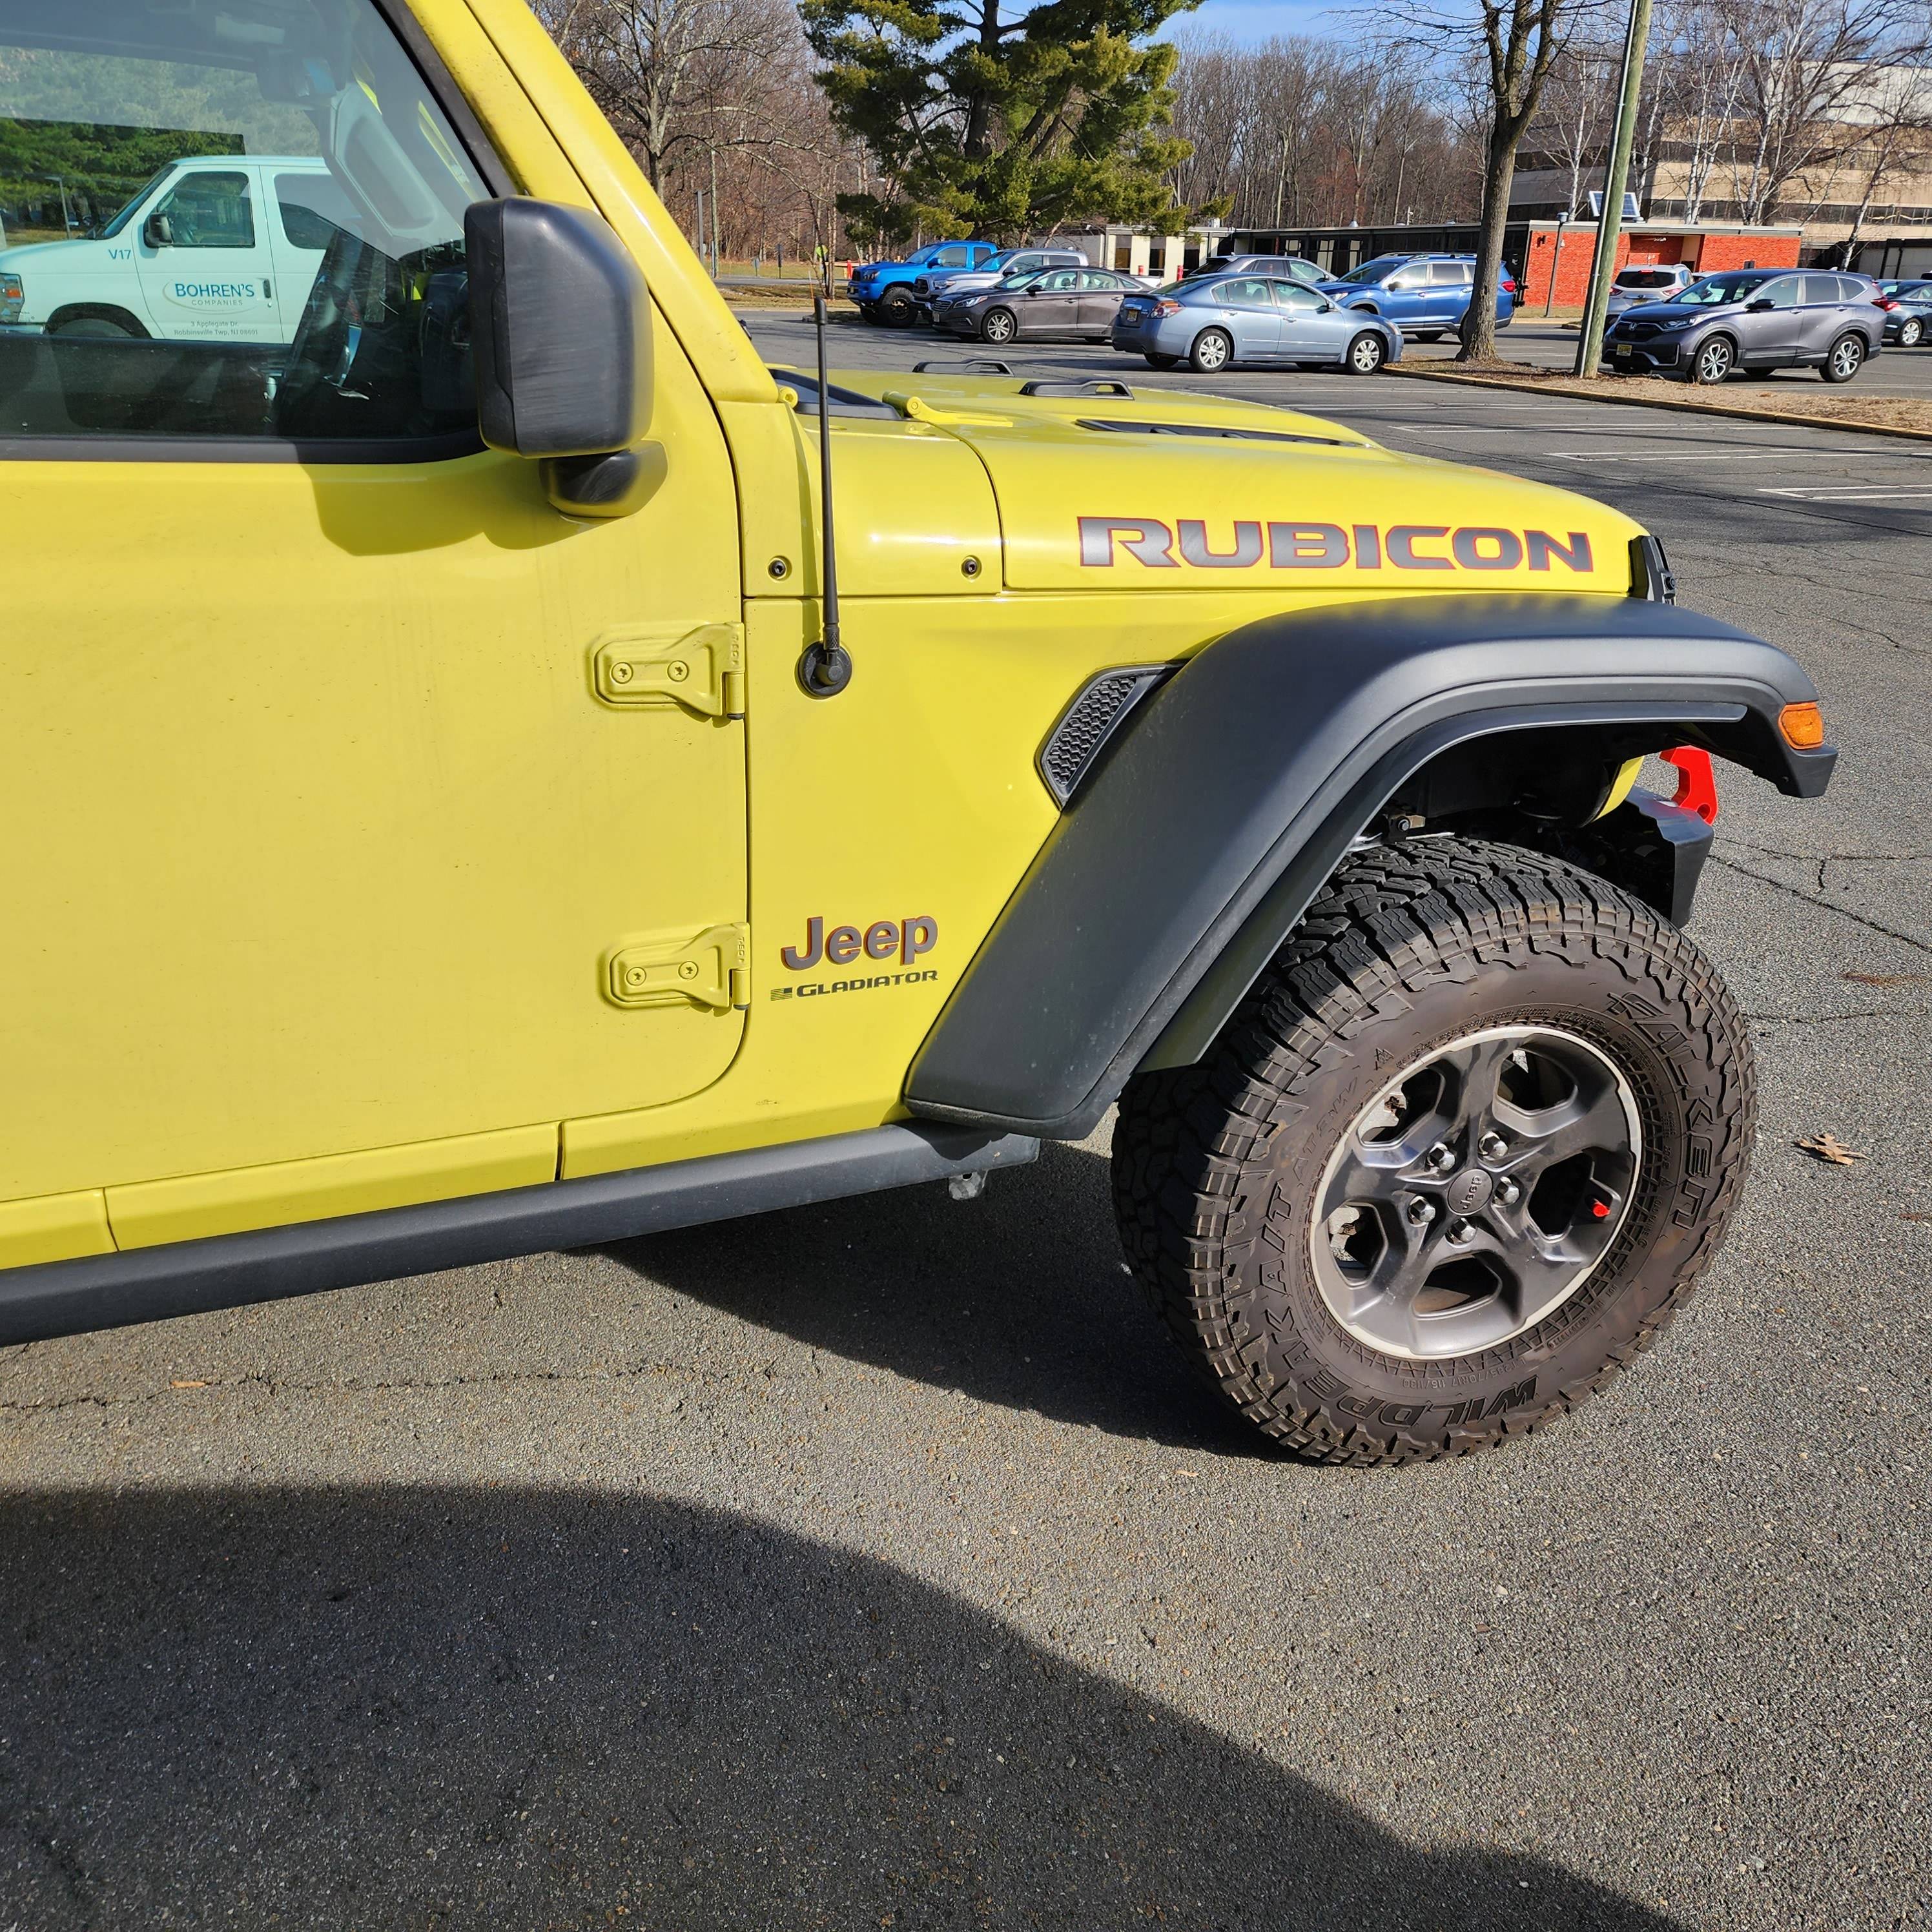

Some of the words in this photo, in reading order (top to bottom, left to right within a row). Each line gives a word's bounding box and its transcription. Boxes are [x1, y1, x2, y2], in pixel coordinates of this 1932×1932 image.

[108, 249, 132, 260] V17
[174, 283, 255, 298] BOHREN'S
[1076, 516, 1594, 573] RUBICON
[781, 914, 939, 971] Jeep
[796, 969, 939, 998] GLADIATOR
[1607, 991, 1715, 1230] FALKEN
[1459, 1175, 1483, 1210] Jeep
[1264, 1306, 1540, 1429] WILDPEAK
